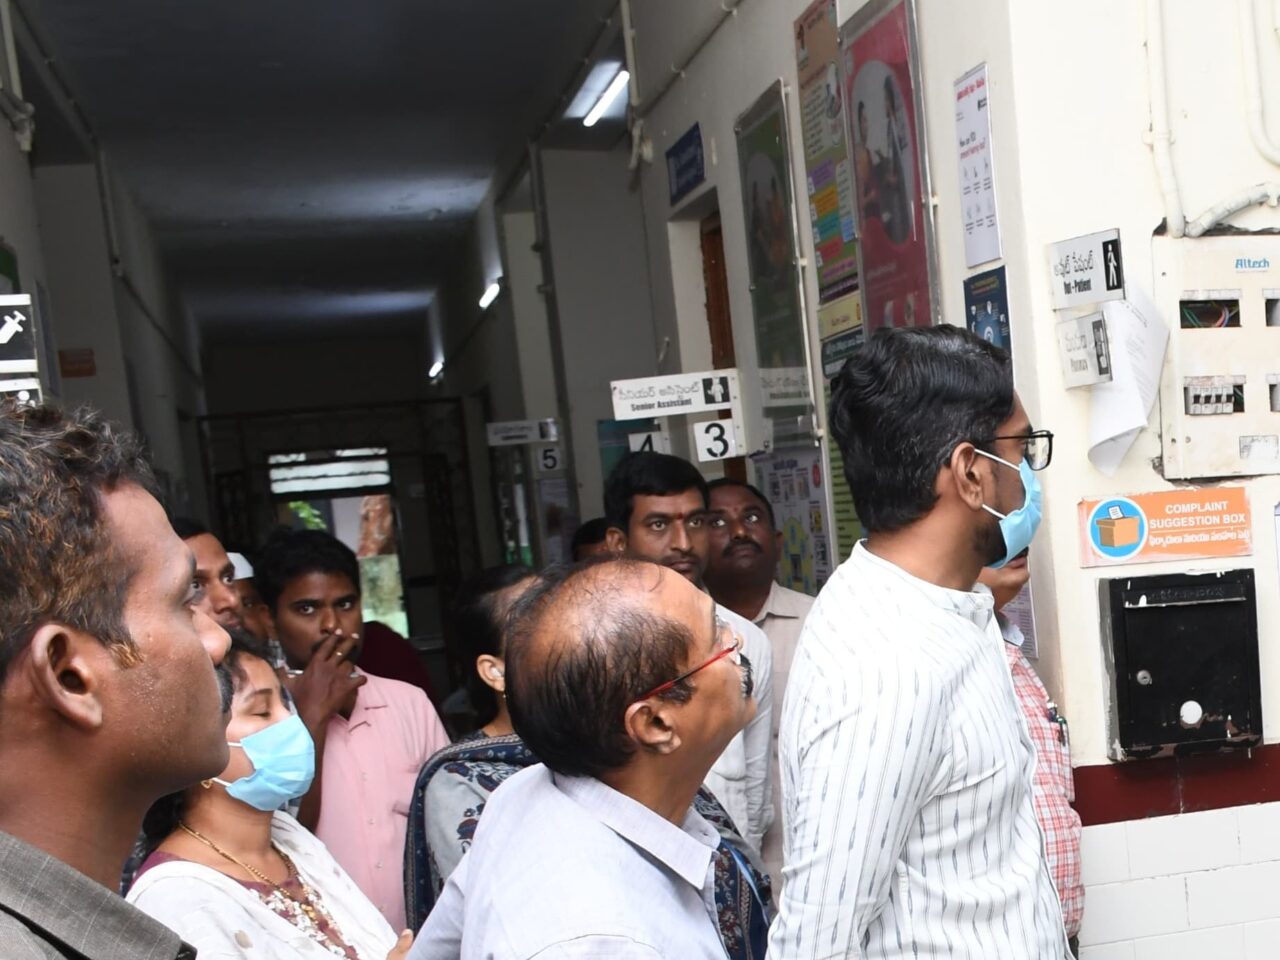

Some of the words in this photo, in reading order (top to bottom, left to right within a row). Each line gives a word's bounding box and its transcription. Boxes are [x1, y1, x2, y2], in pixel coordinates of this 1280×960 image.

[631, 401, 655, 412] Senior
[657, 398, 692, 410] Assistant
[704, 422, 729, 458] 3
[543, 449, 557, 469] 5
[1165, 501, 1228, 514] COMPLAINT
[1150, 515, 1220, 529] SUGGESTION
[1223, 513, 1245, 524] BOX
